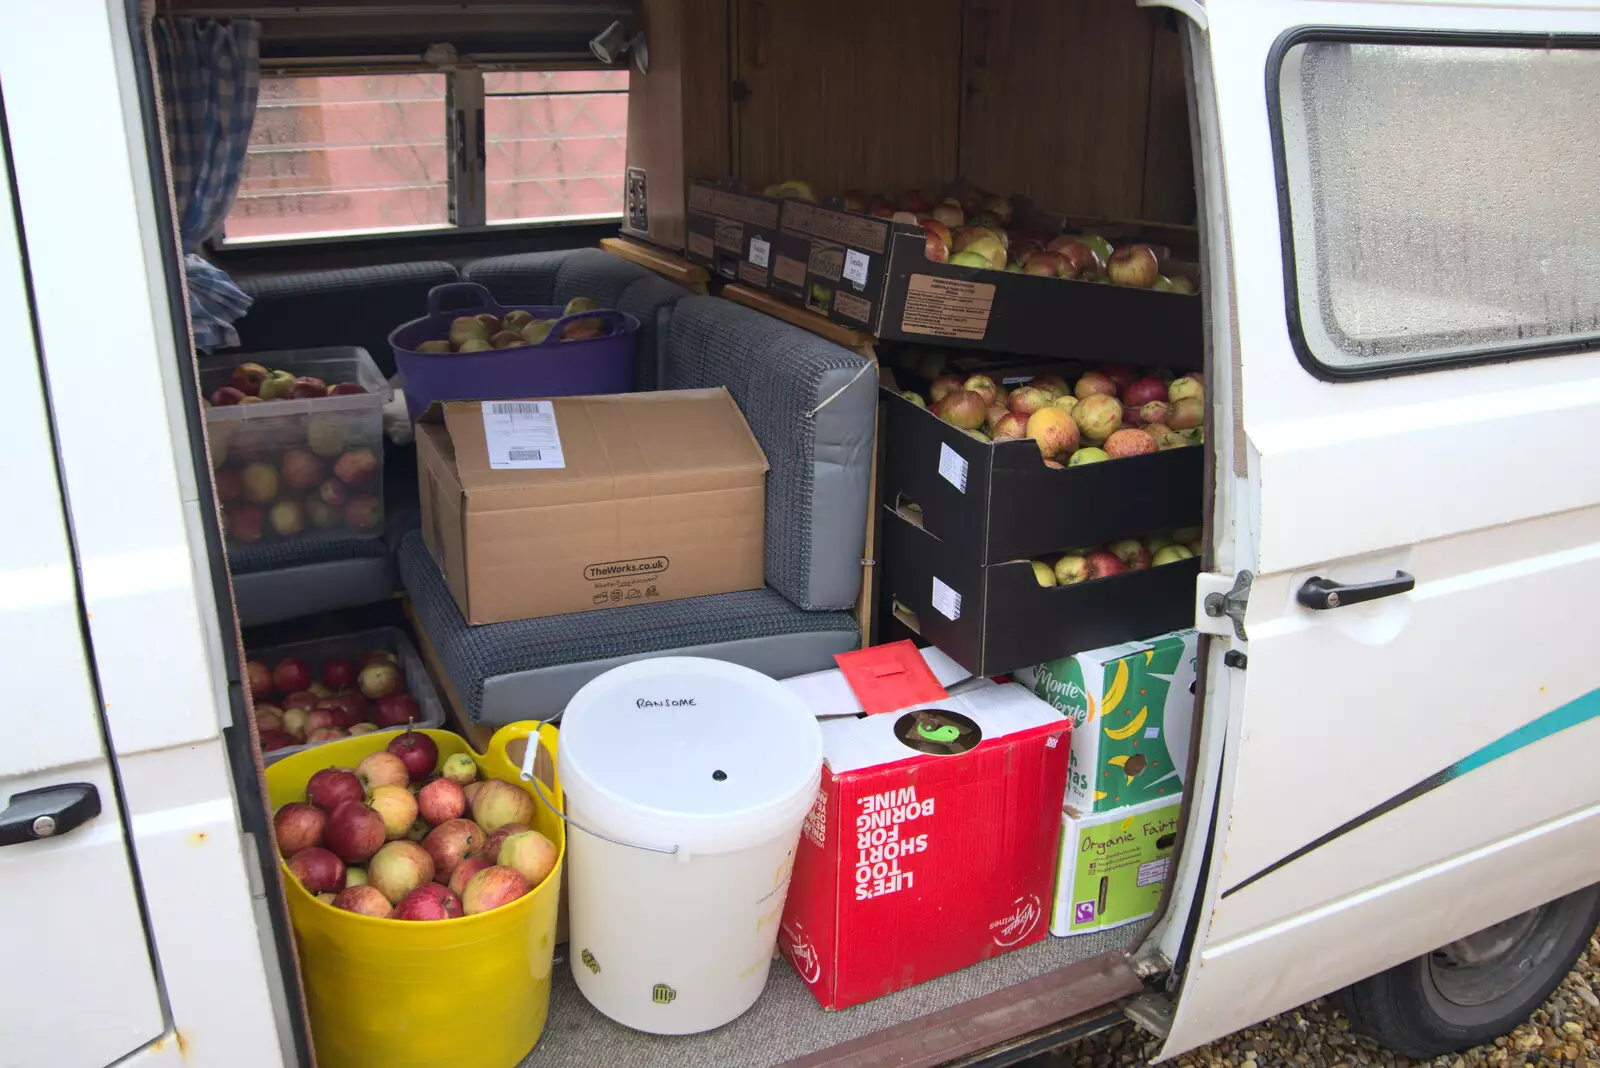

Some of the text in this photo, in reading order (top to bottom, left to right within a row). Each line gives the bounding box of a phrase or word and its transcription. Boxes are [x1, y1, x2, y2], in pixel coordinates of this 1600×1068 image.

[590, 560, 663, 577] TheWorks.co.uk
[1034, 665, 1080, 699] Monte
[636, 698, 697, 709] RANSOME
[1047, 693, 1086, 721] Verde
[857, 785, 917, 813] WINE.
[856, 798, 935, 833] BORING
[856, 834, 928, 868] SHORT
[857, 824, 900, 850] FOR
[1081, 831, 1136, 855] Organic
[856, 859, 901, 884] TOO
[856, 871, 913, 901] LIFE'S
